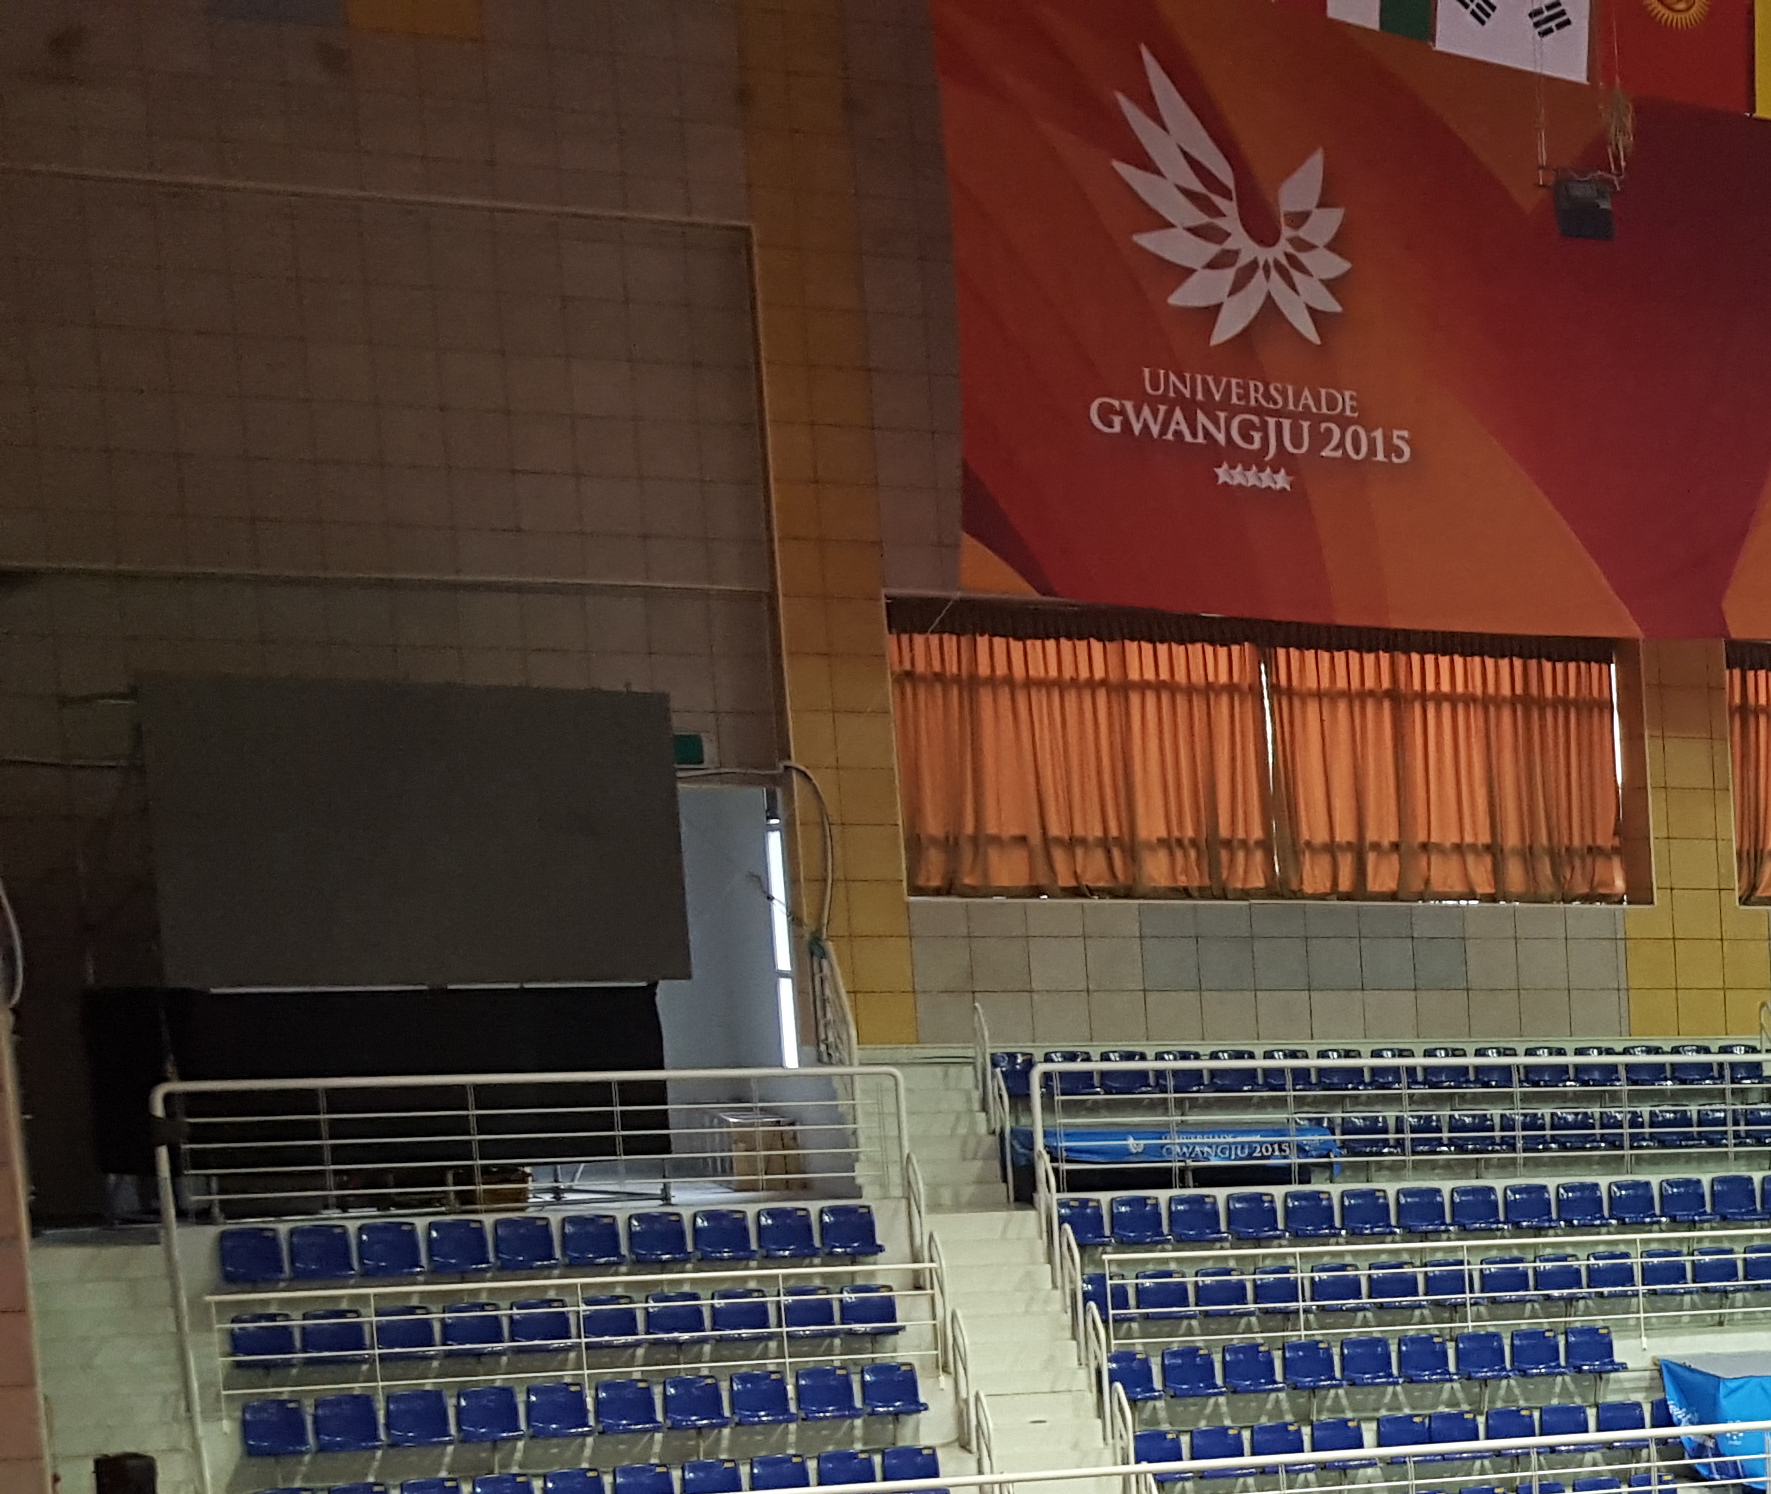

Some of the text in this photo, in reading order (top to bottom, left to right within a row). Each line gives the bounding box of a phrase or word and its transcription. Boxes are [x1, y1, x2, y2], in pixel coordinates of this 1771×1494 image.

[1142, 366, 1358, 419] UNIVERSIADE
[1088, 397, 1411, 466] GWANGJU 2015
[1253, 1143, 1290, 1157] 2015
